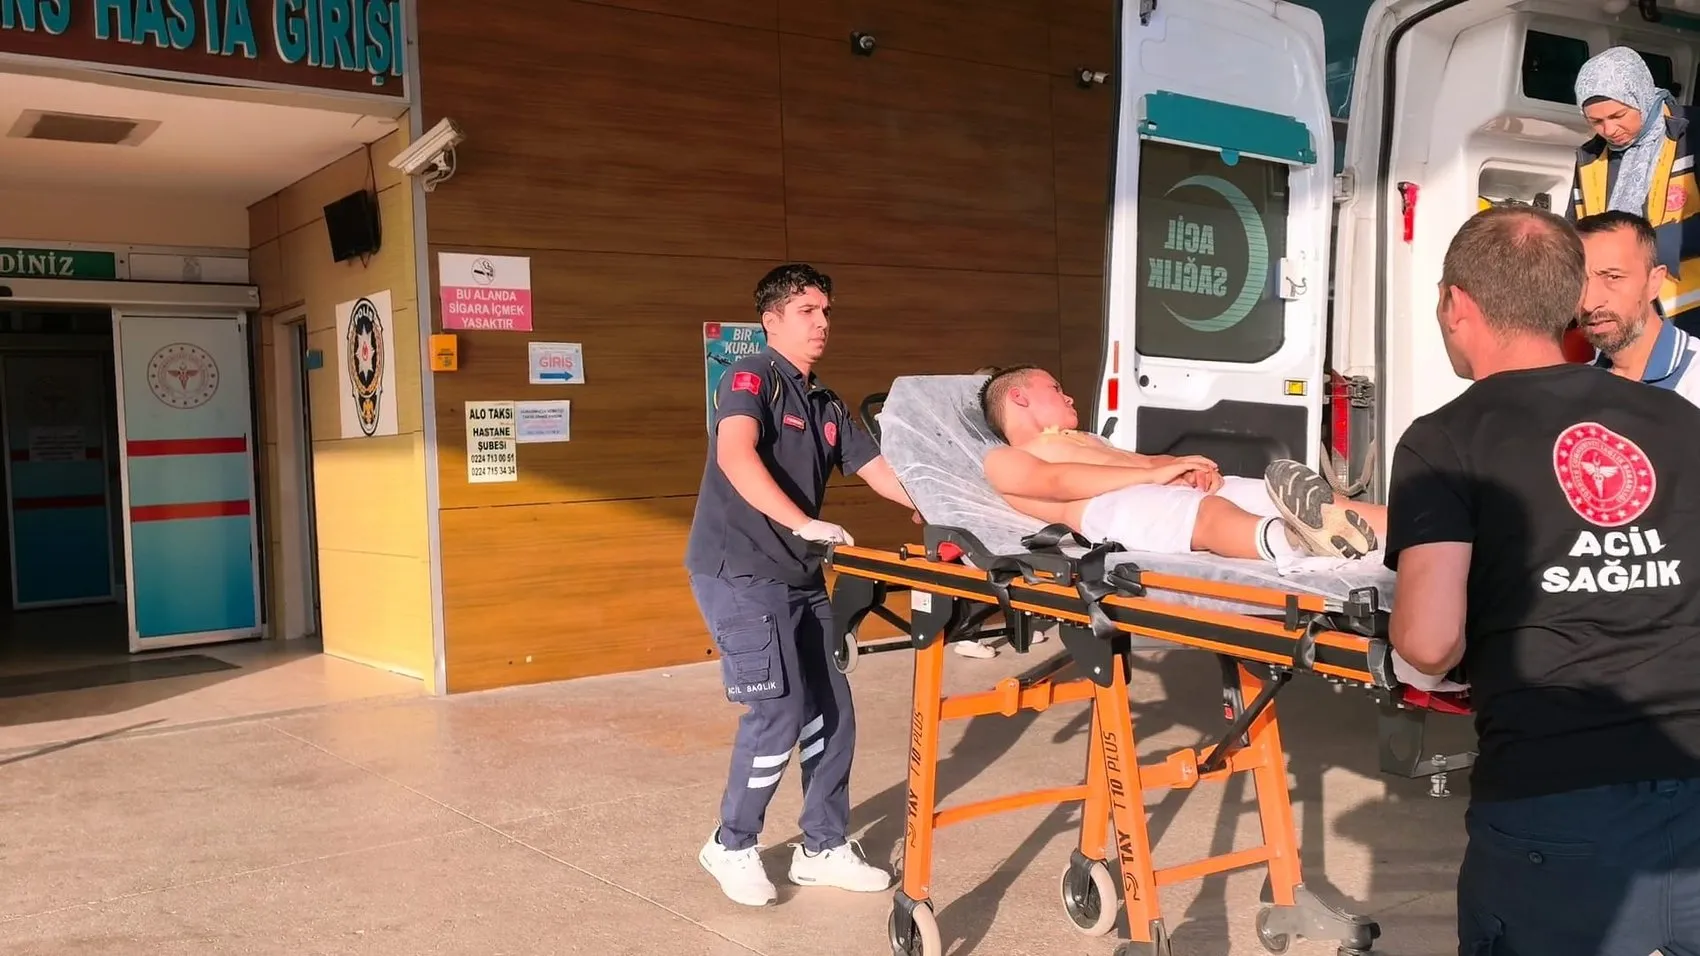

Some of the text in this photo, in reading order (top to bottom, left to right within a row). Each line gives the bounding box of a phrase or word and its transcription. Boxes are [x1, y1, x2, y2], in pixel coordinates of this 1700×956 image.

[94, 0, 258, 59] HASTA
[456, 288, 517, 301] BU ALANDA
[449, 301, 525, 317] SİGARA İÇMEK
[461, 318, 514, 329] YASAKTIR
[733, 327, 752, 341] BİR
[724, 341, 761, 355] KURAL
[469, 408, 486, 420] ALO
[472, 427, 511, 437] HASTANE
[470, 453, 515, 463] 0224 713 00 51
[471, 466, 516, 476] 0224 715 34 34
[1568, 526, 1667, 557] ACİL
[1541, 558, 1682, 593] SAĞLIK
[913, 711, 924, 747] PLUS
[911, 748, 921, 766] 10
[1102, 731, 1121, 773] PLUS
[1109, 778, 1124, 796] 10
[908, 788, 919, 818] TAY
[1117, 829, 1134, 864] TAY
